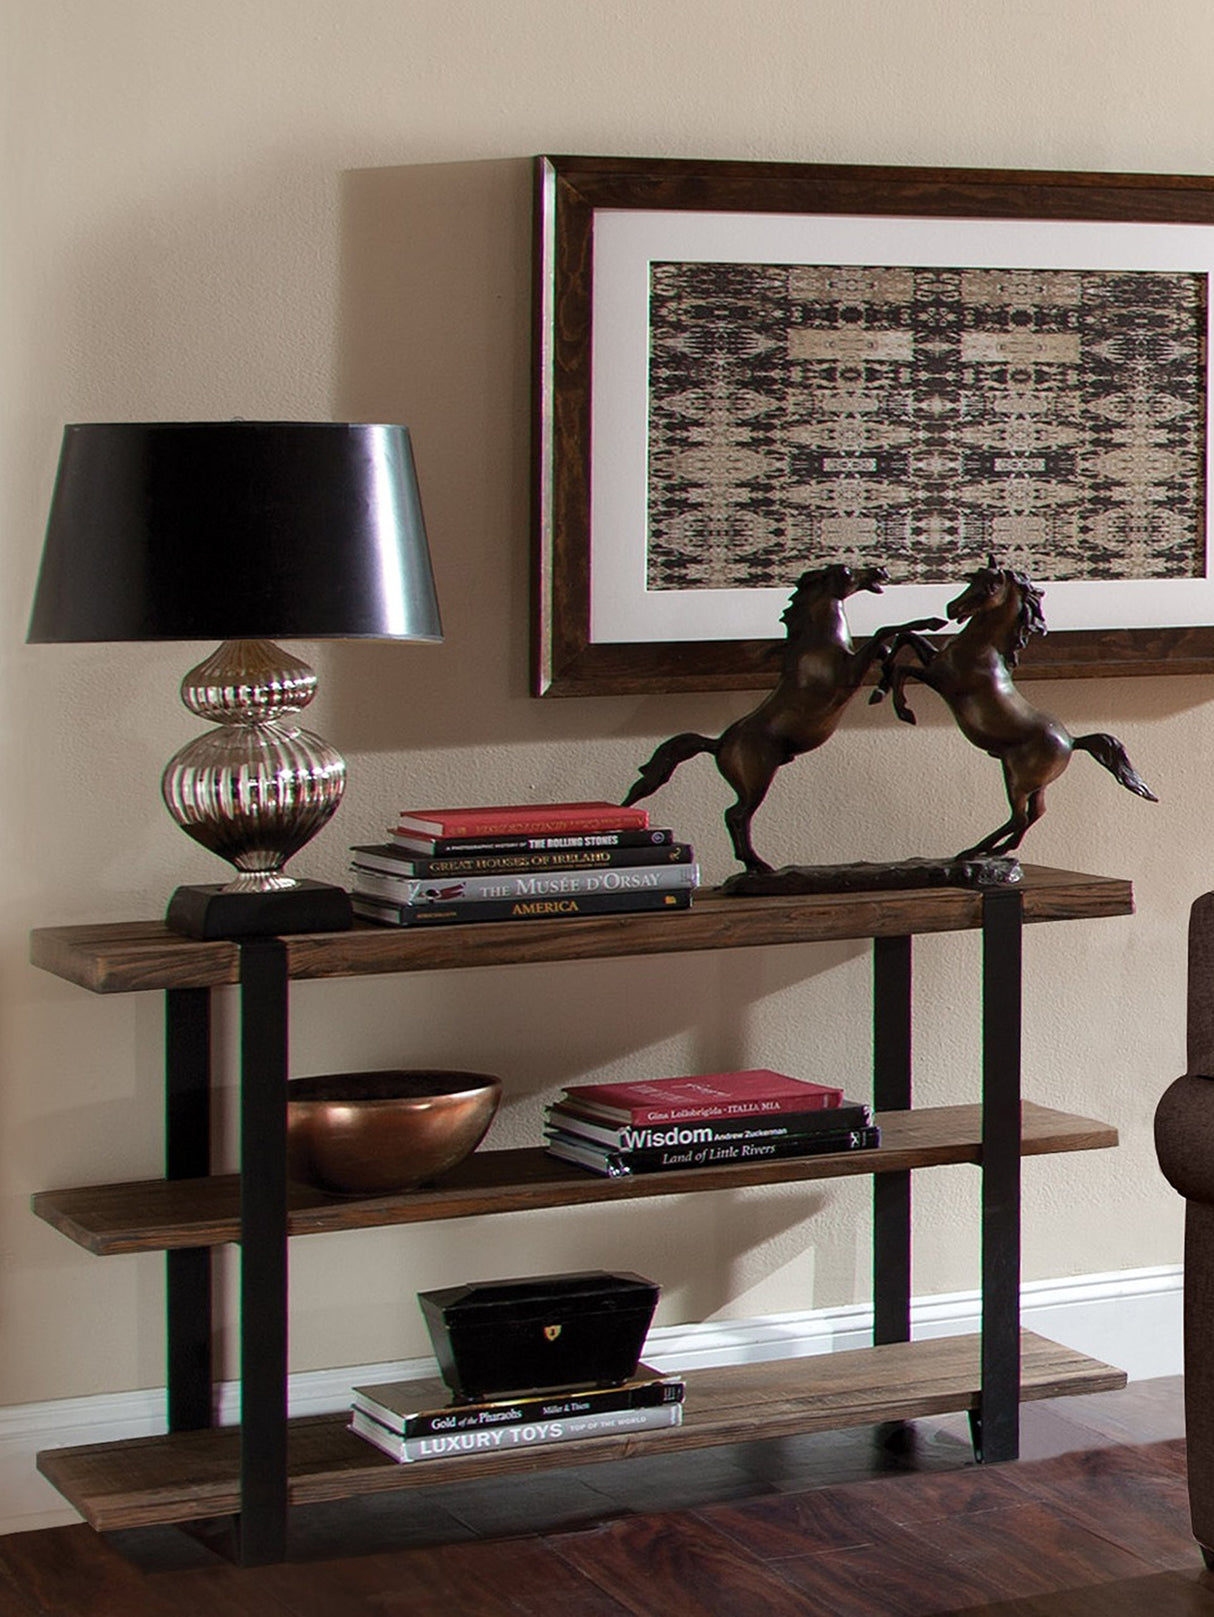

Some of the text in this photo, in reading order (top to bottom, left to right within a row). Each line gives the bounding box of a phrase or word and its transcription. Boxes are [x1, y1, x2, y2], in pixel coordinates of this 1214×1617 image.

[529, 839, 546, 849] THE
[547, 837, 583, 848] ROLLING
[584, 835, 619, 847] STONES
[429, 860, 473, 872] GREAT
[476, 856, 530, 869] HOUSES
[531, 855, 549, 866] OF
[553, 852, 611, 864] IRELAND
[480, 885, 510, 898] THE
[516, 877, 581, 896] MUSÉE
[512, 901, 580, 915] AMERICA
[647, 1112, 669, 1121] Gina
[728, 1103, 760, 1114] ITALIA
[762, 1101, 781, 1111] MIA
[625, 1127, 788, 1149] Wisdom Andrew Zuckerman
[662, 1143, 776, 1165] Land of Little Rivers
[431, 1408, 523, 1430] Gold of the Pharaohs
[570, 1416, 647, 1432] TOP OF THE WORLD
[420, 1423, 564, 1455] LUXURY TOYS
